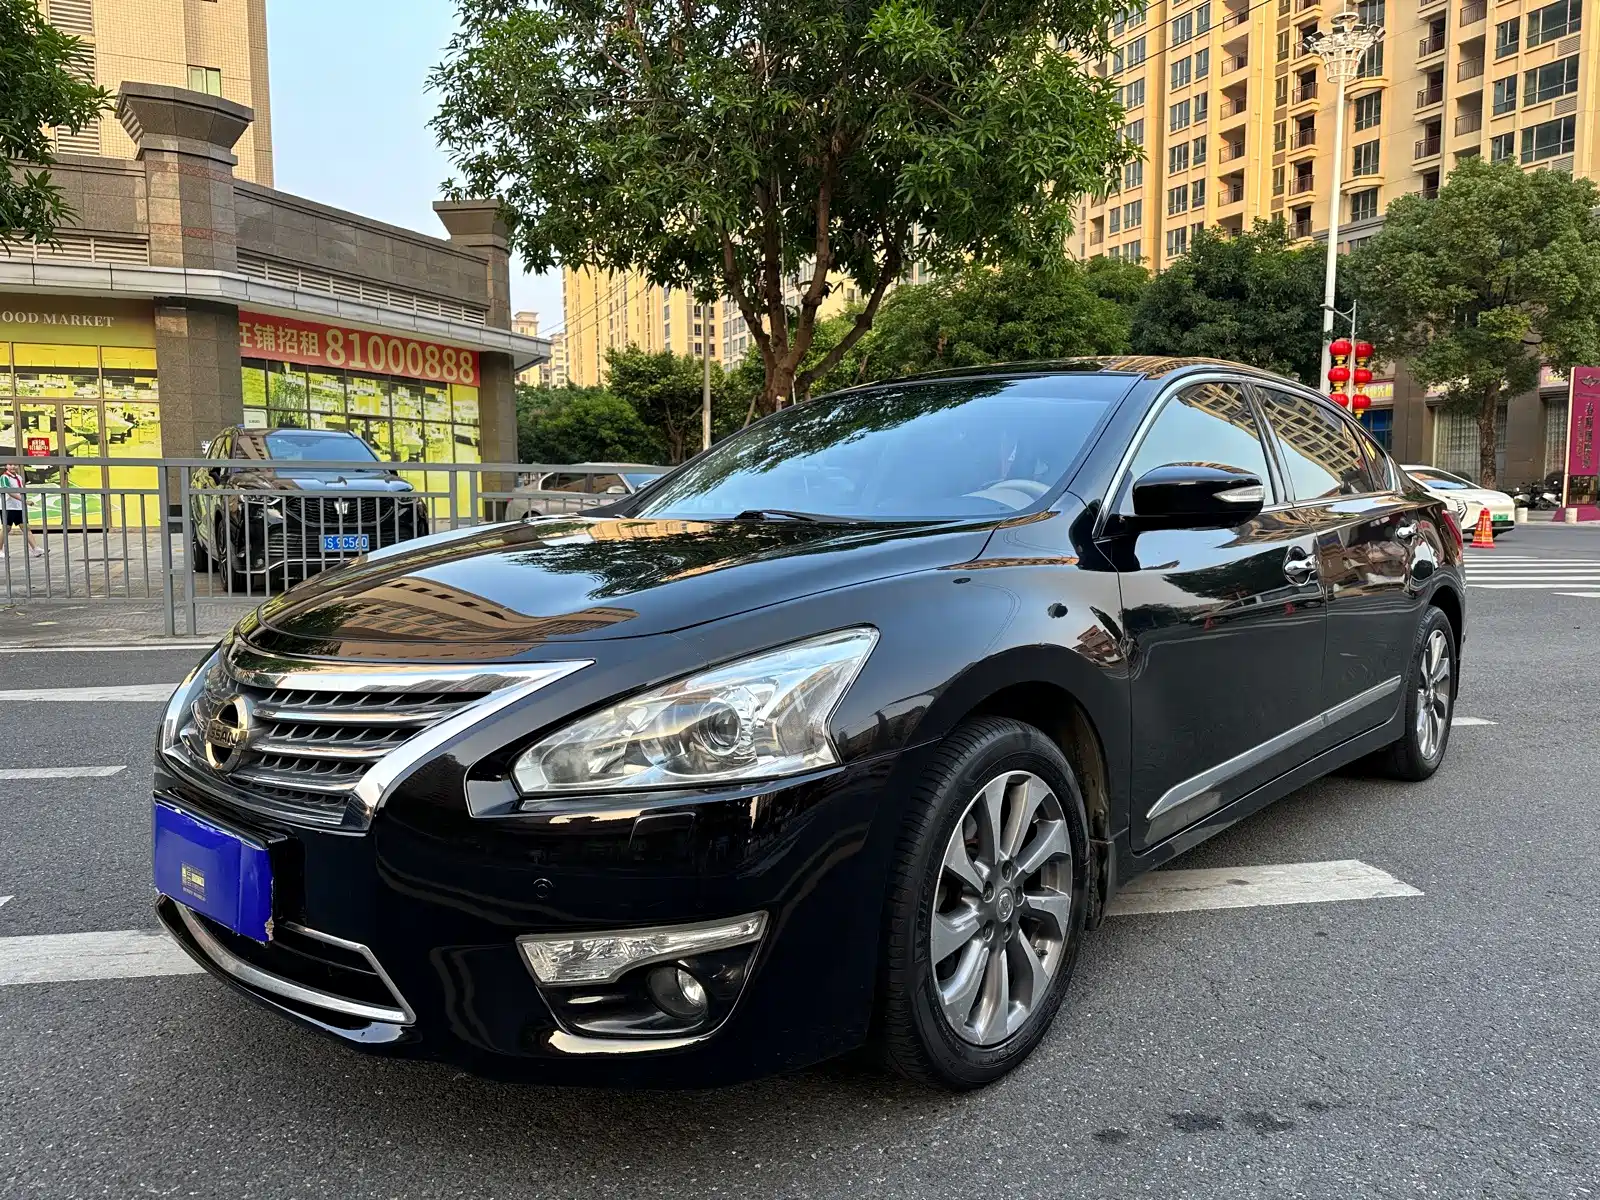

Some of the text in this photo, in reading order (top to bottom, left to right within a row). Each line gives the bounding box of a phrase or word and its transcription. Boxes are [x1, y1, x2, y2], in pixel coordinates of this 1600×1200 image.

[0, 310, 114, 328] OOD MARKET
[325, 328, 474, 384] 81000888
